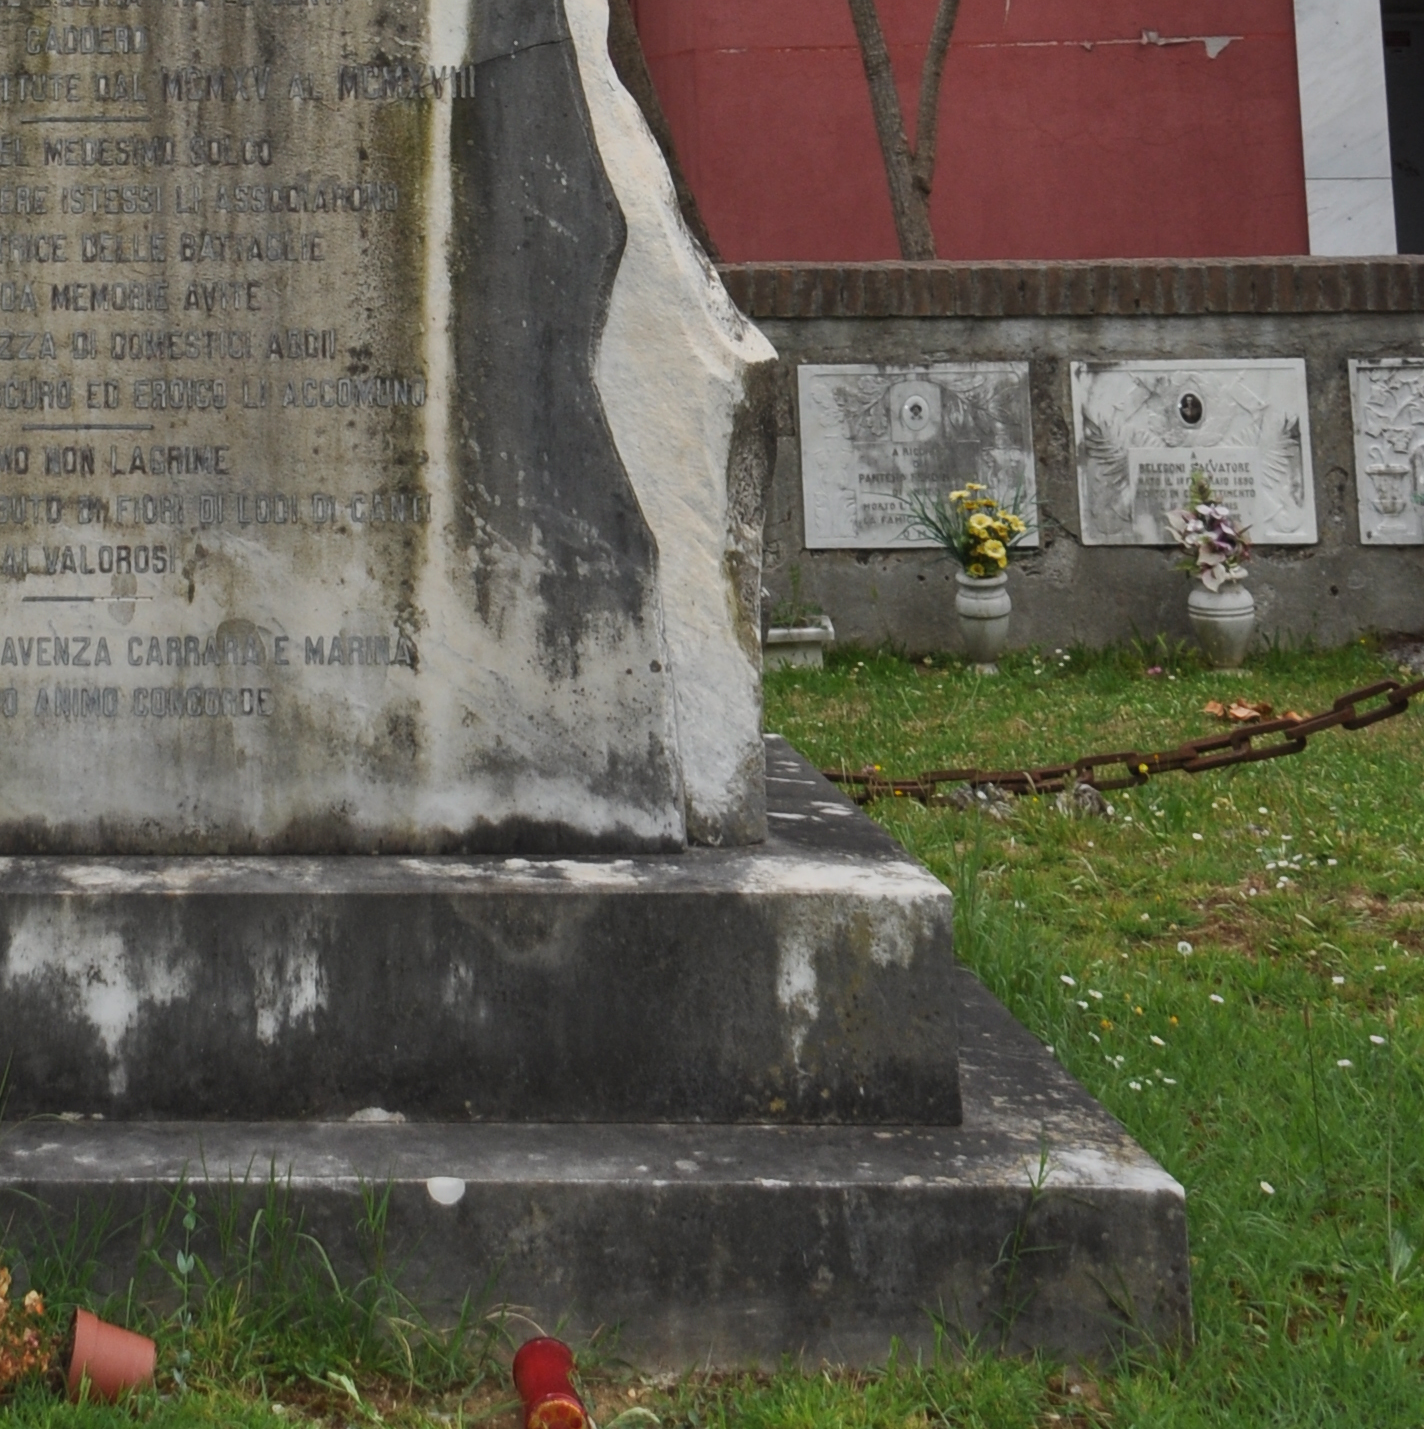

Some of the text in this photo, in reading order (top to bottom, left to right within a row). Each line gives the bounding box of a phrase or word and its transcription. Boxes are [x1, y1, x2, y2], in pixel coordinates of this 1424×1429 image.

[25, 26, 149, 55] CADDERO
[94, 73, 148, 104] DAL
[161, 66, 274, 101] MCMXV
[288, 72, 324, 101] AL
[337, 64, 477, 100] MCMXVIII
[43, 138, 174, 166] MEDESIMO
[188, 138, 274, 166] SOLCO
[62, 185, 162, 215] ISTESSI
[175, 185, 201, 215] LI
[214, 182, 399, 213] ASSOCIARONO
[81, 233, 167, 263] DELLE
[179, 233, 326, 263] BATTAGLIE
[0, 282, 39, 311] DA
[50, 282, 170, 311] MEMORIE
[182, 282, 263, 311] AVITE
[71, 330, 97, 360] DI
[110, 330, 252, 360] DOMESTICI
[86, 379, 119, 409] ED
[133, 379, 229, 409] EROICO
[242, 379, 266, 409] LI
[43, 445, 96, 476] NON
[109, 445, 230, 476] LAGRIME
[1190, 463, 1250, 473] SALVATORE
[77, 495, 105, 525] DI
[116, 495, 184, 525] FIORI
[197, 495, 224, 525] DI
[236, 495, 299, 525] LODI
[310, 495, 337, 525] DI
[350, 495, 433, 525] CANTI
[1, 545, 177, 575] AI VALOROSI
[126, 637, 266, 667] CARRARA
[275, 637, 291, 667] E
[303, 637, 414, 667] MARINA
[34, 687, 119, 718] ANIMO
[131, 687, 273, 718] CONCORDE
